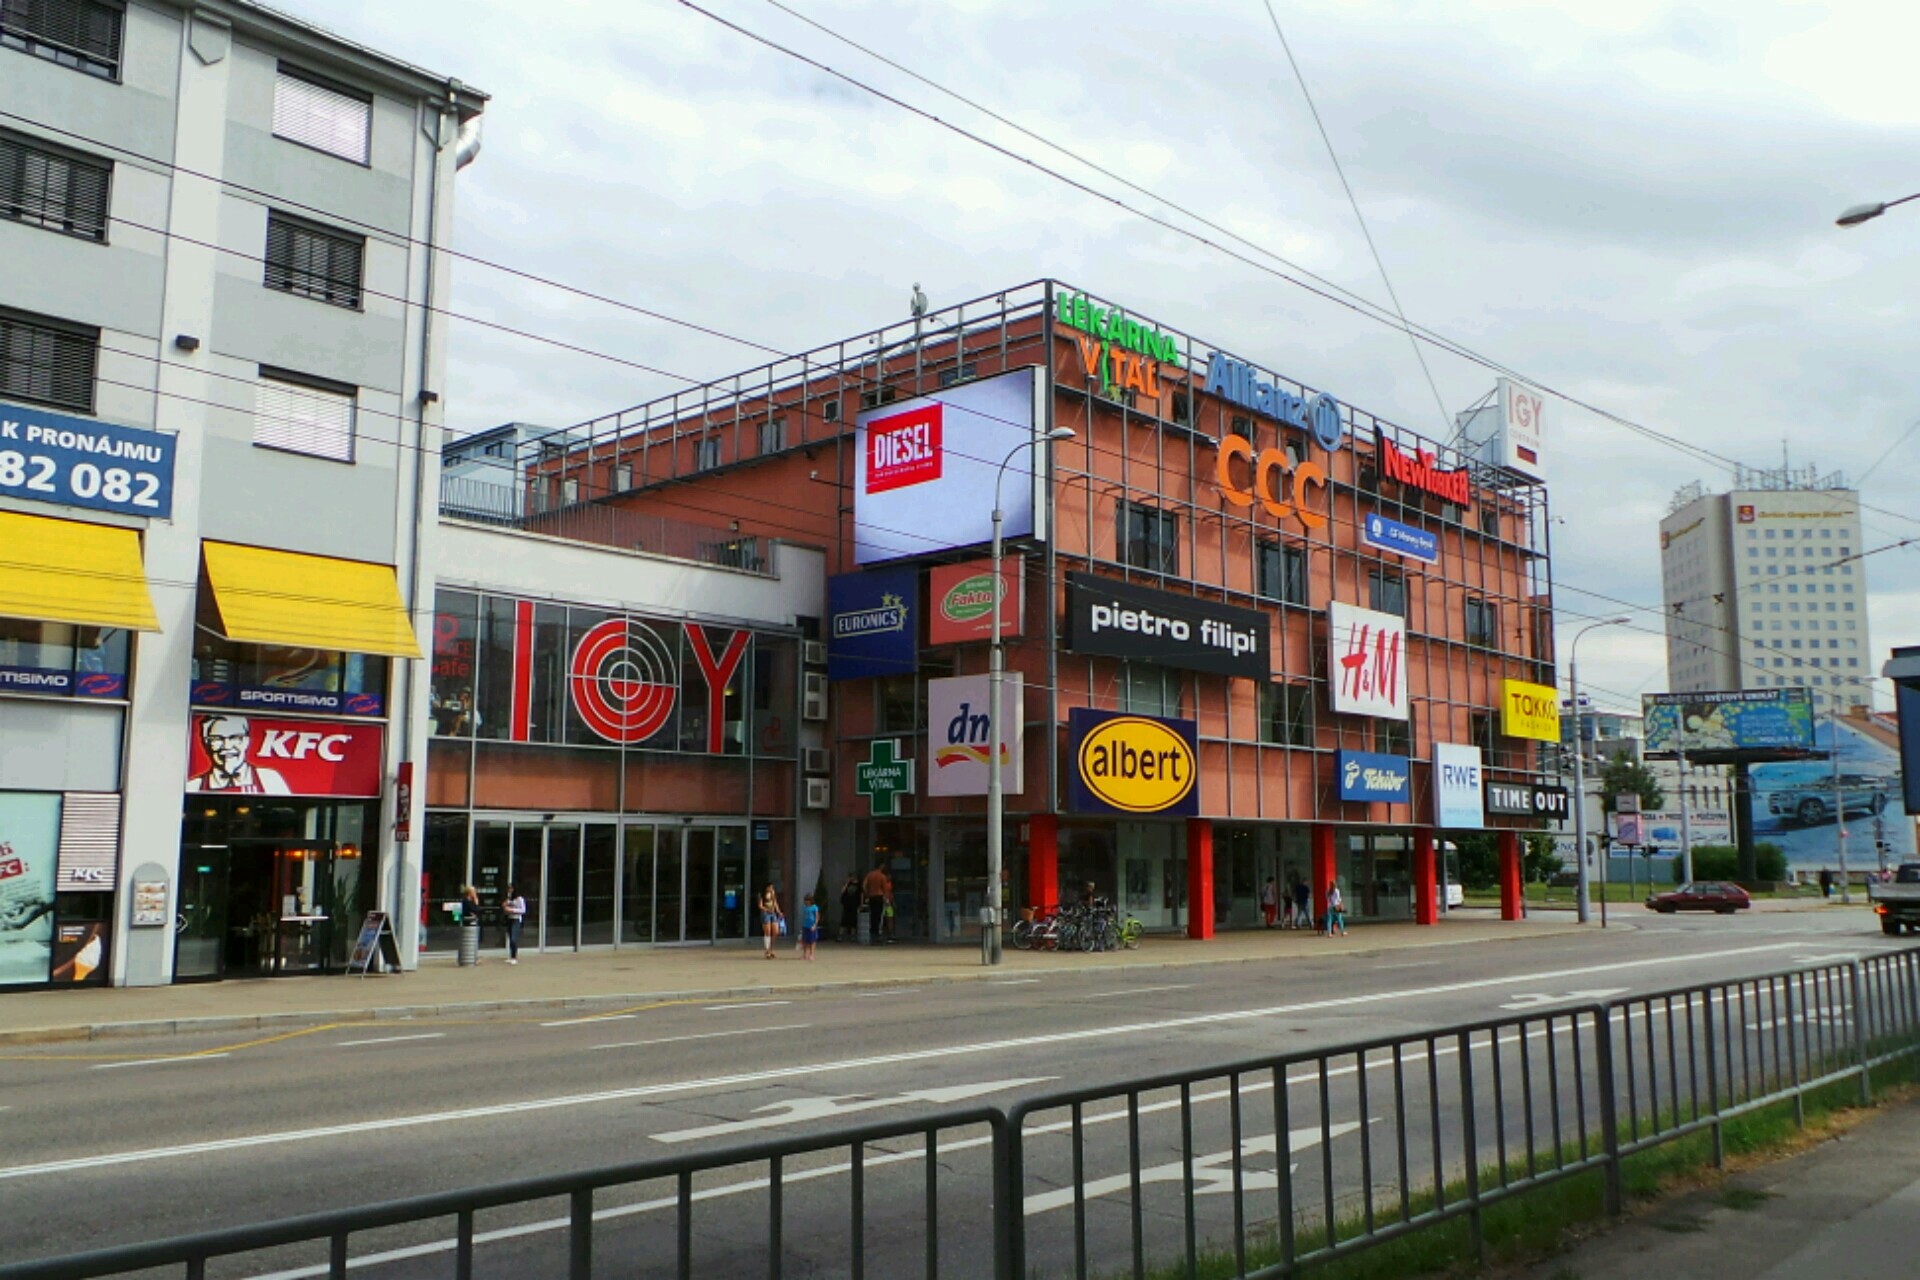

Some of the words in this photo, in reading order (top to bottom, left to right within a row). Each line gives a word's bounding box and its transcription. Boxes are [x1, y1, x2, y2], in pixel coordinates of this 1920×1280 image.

[1057, 291, 1179, 366] LÉKÁRNA
[1079, 335, 1160, 399] VITAL
[1206, 352, 1308, 429] Allianz
[2, 421, 20, 440] K
[27, 425, 161, 463] PRONÁJMU
[70, 463, 160, 508] 082
[1217, 434, 1327, 528] CCC
[838, 612, 898, 632] EURONICS
[1092, 603, 1190, 640] pietro
[1201, 620, 1256, 656] filipi
[1341, 622, 1399, 708] H&M
[240, 690, 338, 707] SPORTISIMO
[257, 729, 352, 761] KFC
[1092, 740, 1181, 782] albert
[1443, 764, 1478, 787] RWE
[1492, 788, 1530, 809] TIME
[1535, 793, 1566, 811] OUT
[72, 866, 104, 881] KFC
